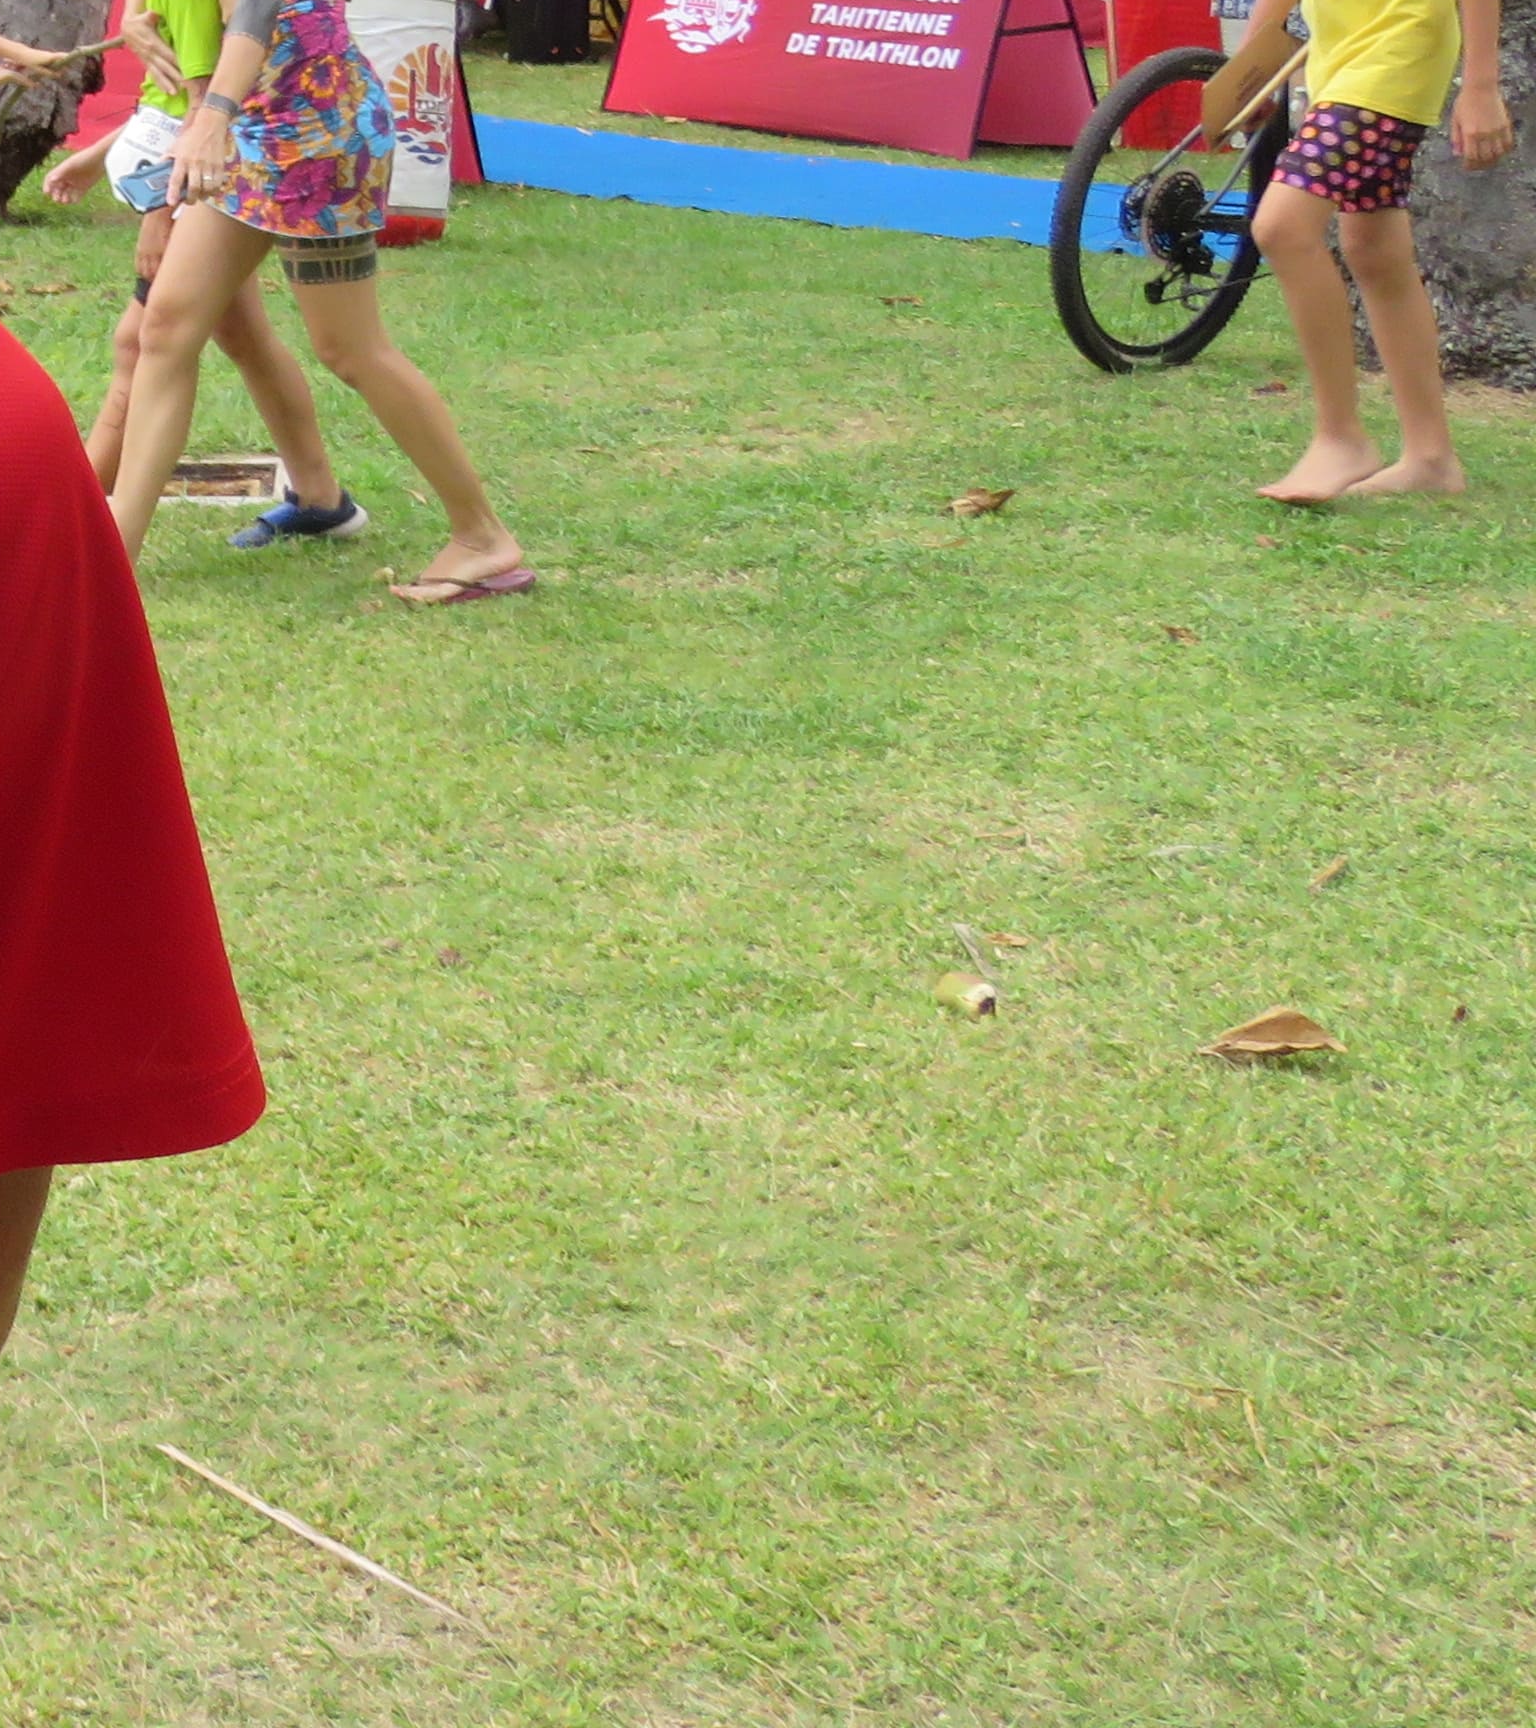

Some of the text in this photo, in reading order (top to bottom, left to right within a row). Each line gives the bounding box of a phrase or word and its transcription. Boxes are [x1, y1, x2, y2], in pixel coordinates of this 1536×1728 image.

[810, 2, 954, 36] TAHITIENNE
[785, 32, 961, 70] DE TRIATHLON
